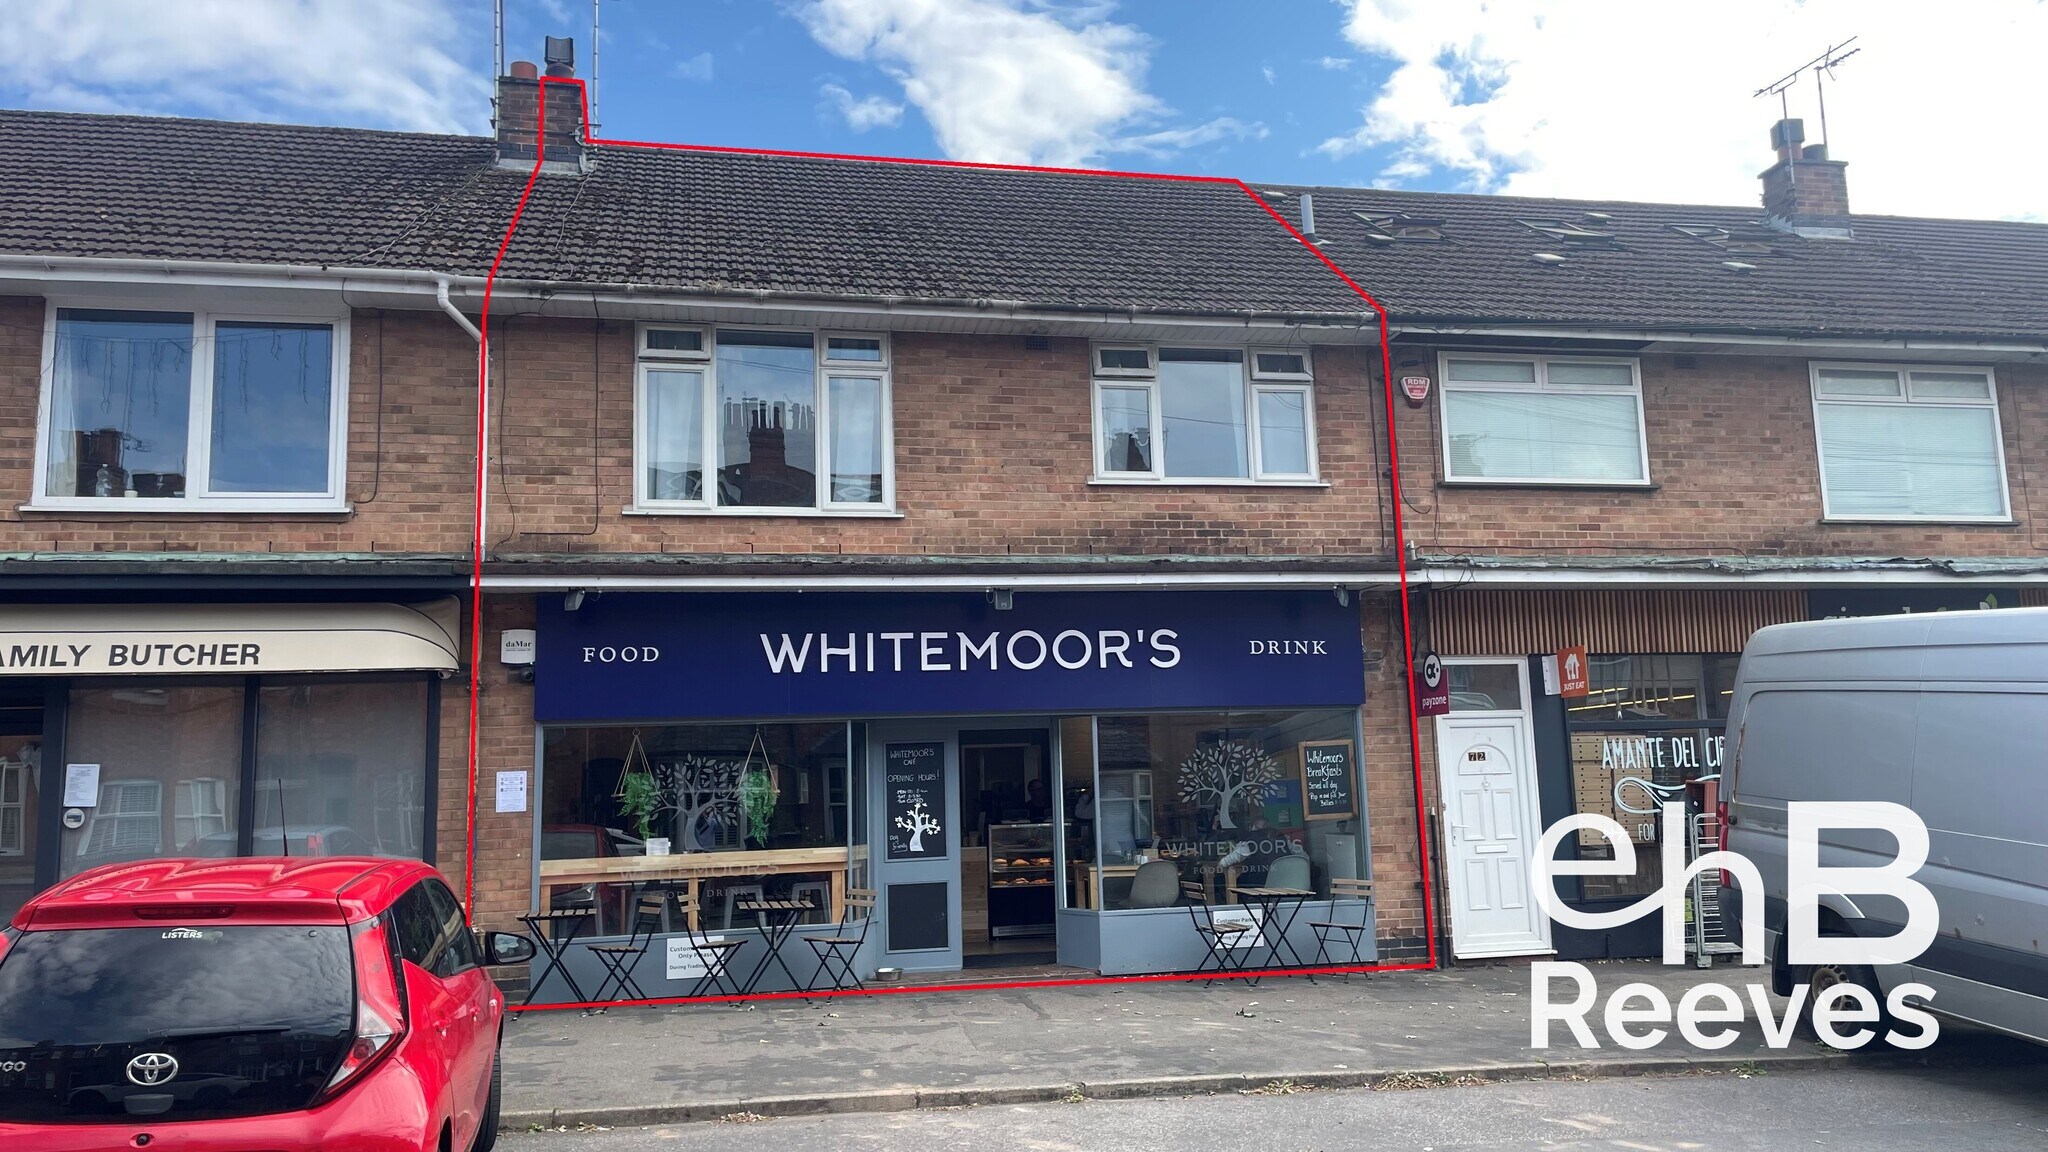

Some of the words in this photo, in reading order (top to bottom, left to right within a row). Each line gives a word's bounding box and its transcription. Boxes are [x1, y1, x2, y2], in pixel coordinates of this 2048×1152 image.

[506, 640, 532, 648] daMar
[1249, 640, 1328, 656] DRINK
[0, 644, 91, 668] MILY
[108, 644, 260, 666] BUTCHER
[583, 647, 659, 663] FOOD
[760, 629, 1181, 673] WHITEMOOR'S
[1563, 683, 1576, 692] JUST
[1576, 681, 1585, 690] EAT
[1422, 695, 1447, 709] payzone
[1468, 752, 1486, 761] 72
[1602, 737, 1665, 769] AMANTE
[1672, 736, 1699, 768] DEL
[1638, 824, 1656, 841] FOR
[1193, 866, 1224, 875] FOOD
[1242, 864, 1278, 873] DRINK
[706, 888, 748, 898] DRINK
[162, 931, 203, 939] LISTERS
[0, 1061, 27, 1072] GO
